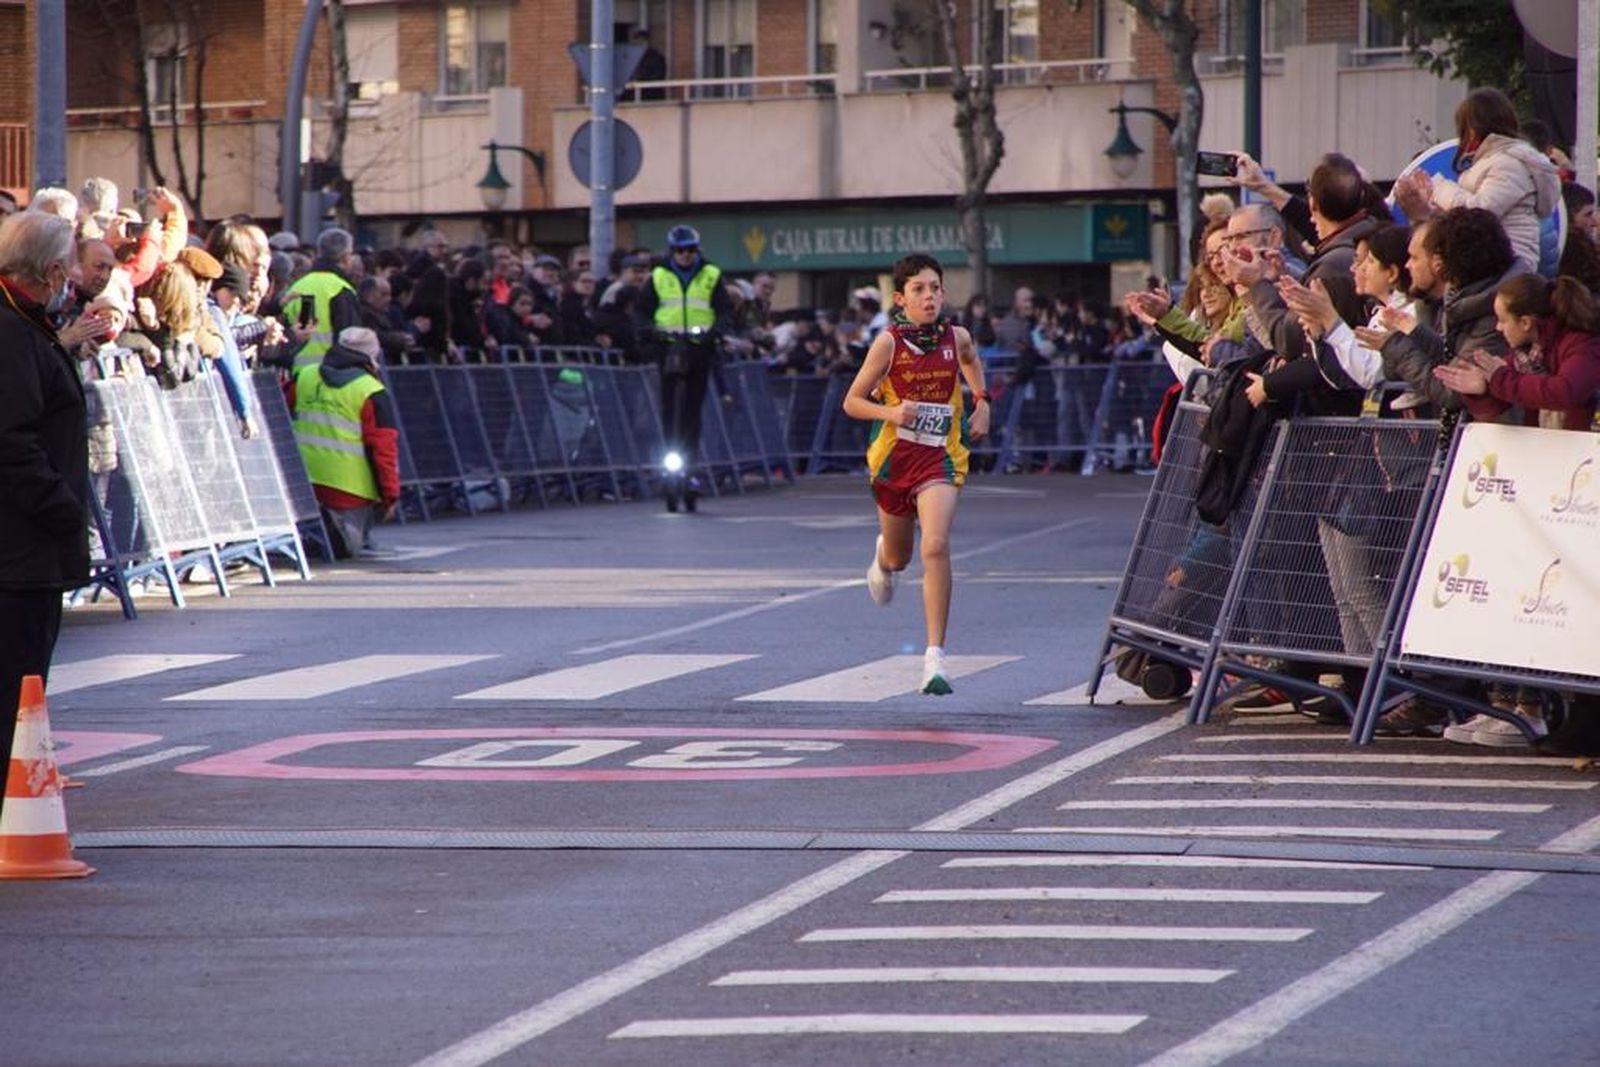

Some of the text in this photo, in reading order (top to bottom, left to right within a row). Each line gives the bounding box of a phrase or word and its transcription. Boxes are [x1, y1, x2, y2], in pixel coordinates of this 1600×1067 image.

[772, 222, 1005, 262] CAJA RURAL DE SALAMACA
[1475, 477, 1517, 496] SETEL
[1445, 577, 1490, 597] SETEL
[414, 738, 845, 768] 30
